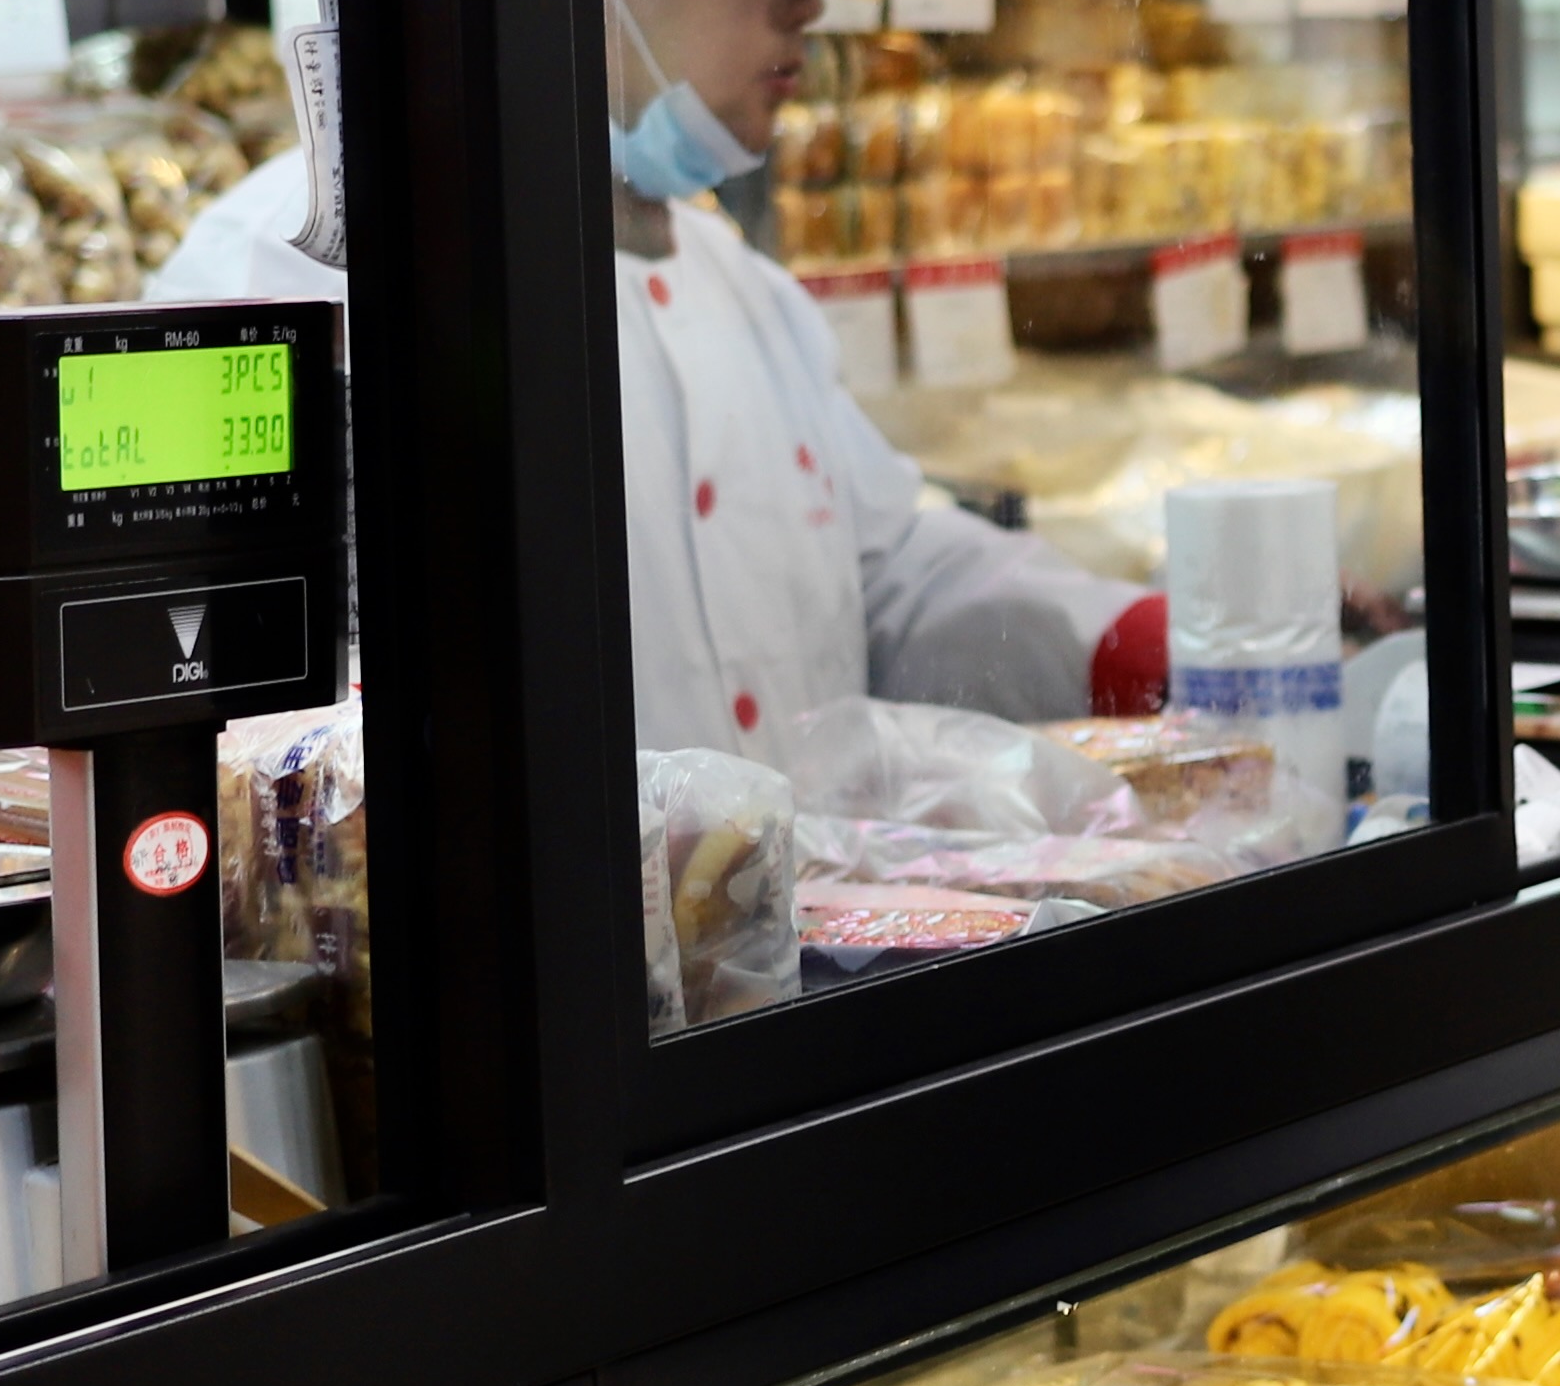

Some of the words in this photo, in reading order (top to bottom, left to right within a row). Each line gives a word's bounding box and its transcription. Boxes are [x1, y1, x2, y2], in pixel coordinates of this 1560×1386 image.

[115, 336, 128, 353] kg
[165, 331, 200, 348] RM-60
[240, 327, 258, 342] 单价
[223, 414, 284, 457] 33.90
[172, 662, 204, 684] DIGI
